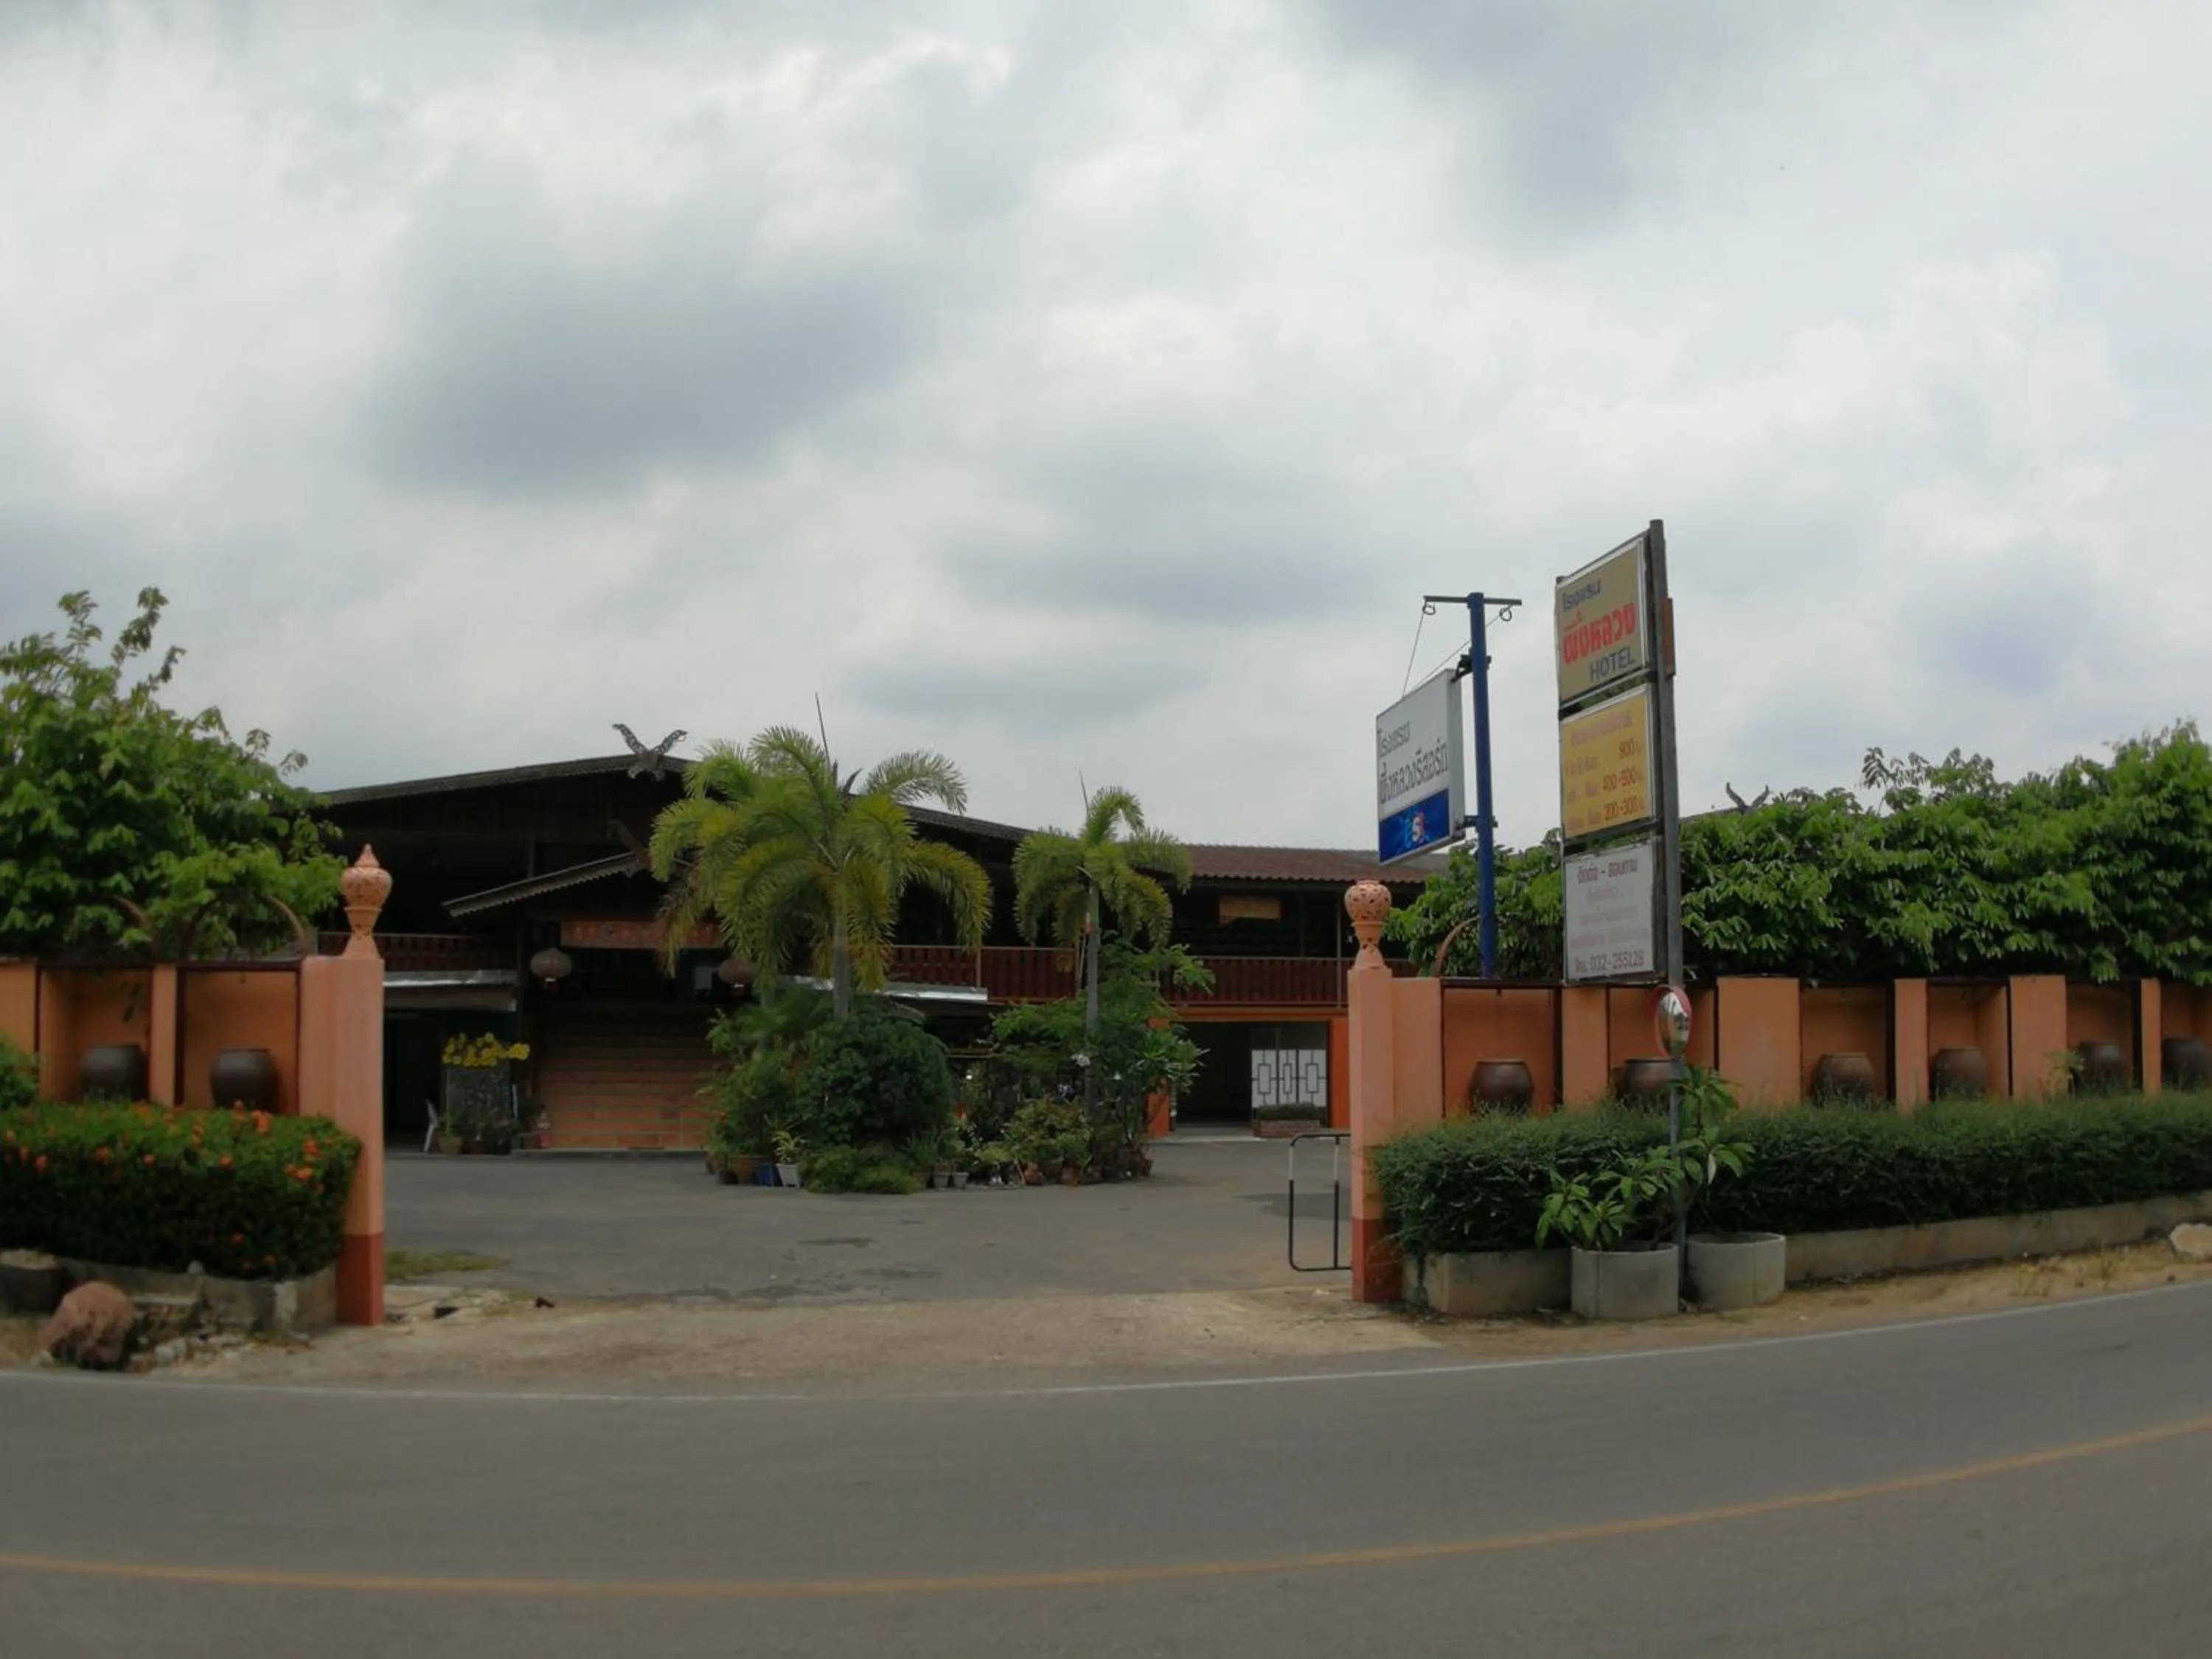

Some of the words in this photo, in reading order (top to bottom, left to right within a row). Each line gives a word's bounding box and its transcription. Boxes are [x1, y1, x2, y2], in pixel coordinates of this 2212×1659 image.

[1590, 647, 1635, 682] HOTEL
[1377, 720, 1411, 757] โรงแรม
